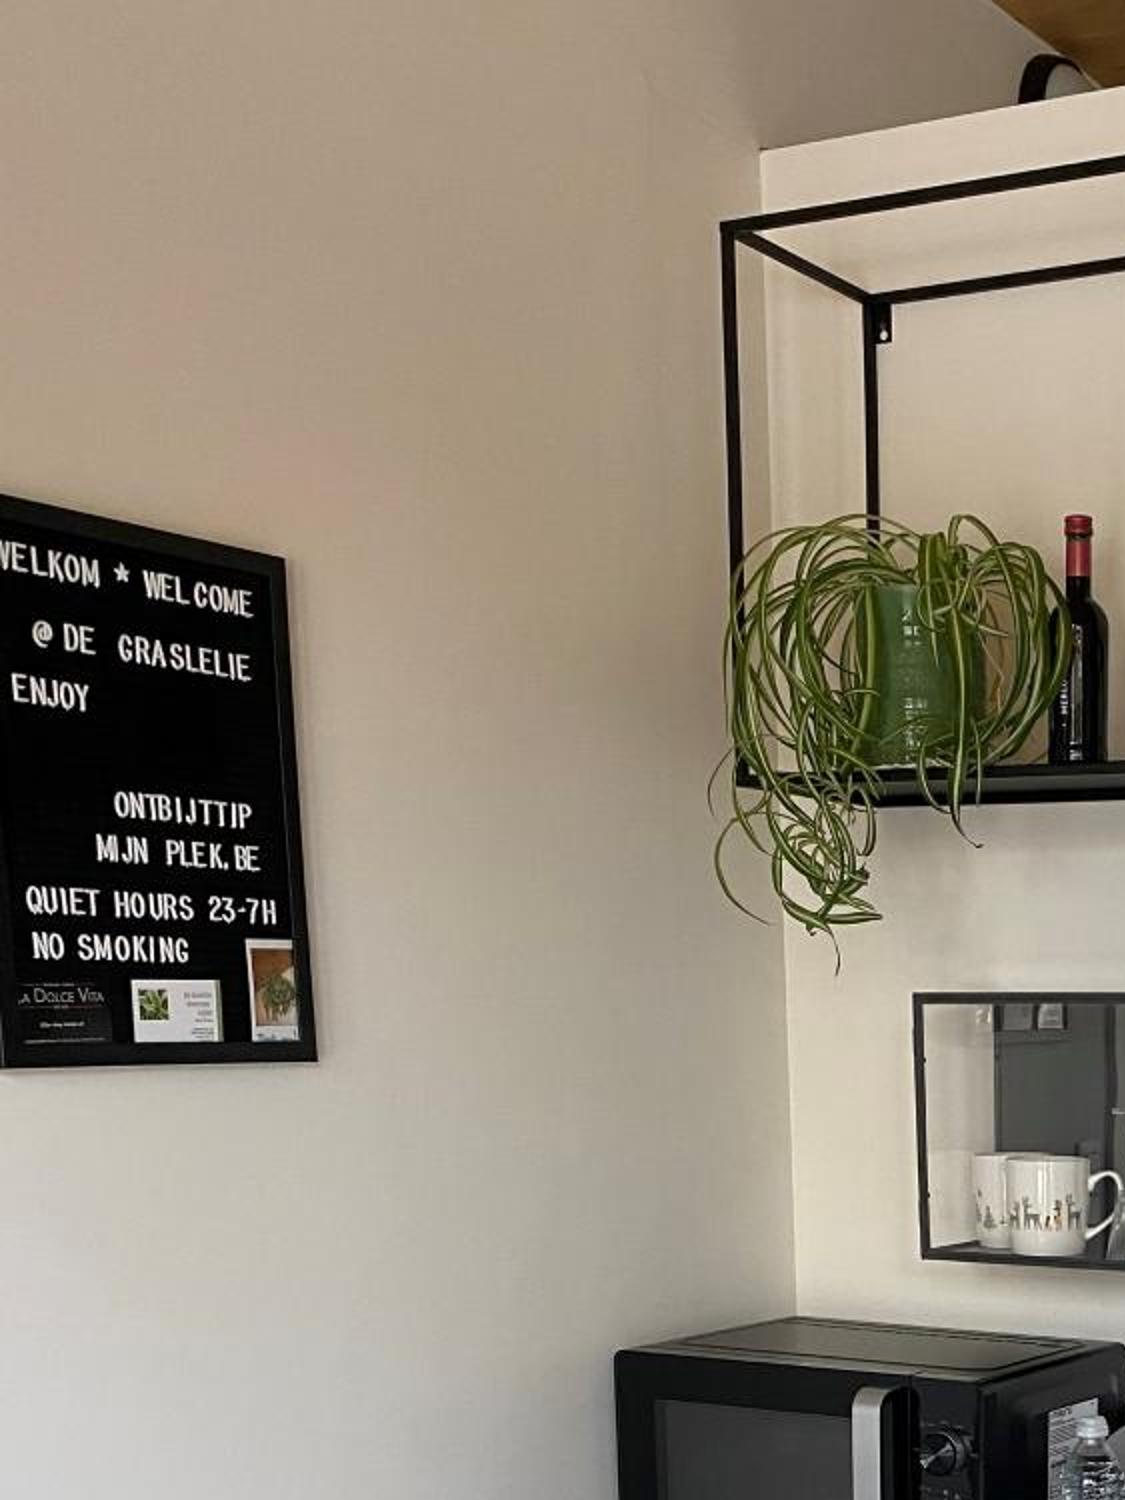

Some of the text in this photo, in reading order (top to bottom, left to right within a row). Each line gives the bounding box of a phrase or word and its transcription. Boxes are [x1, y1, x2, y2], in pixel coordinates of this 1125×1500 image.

[0, 539, 254, 618] WELKOM WELCOME
[63, 623, 97, 655] DE
[117, 633, 252, 682] GRASLELIE
[11, 672, 89, 712] ENJOY
[113, 791, 253, 829] ONTBIJTTIP
[95, 833, 149, 865] MIJN
[25, 885, 277, 925] QUIET HOURS 23-7H
[31, 931, 189, 963] NO SMOKING
